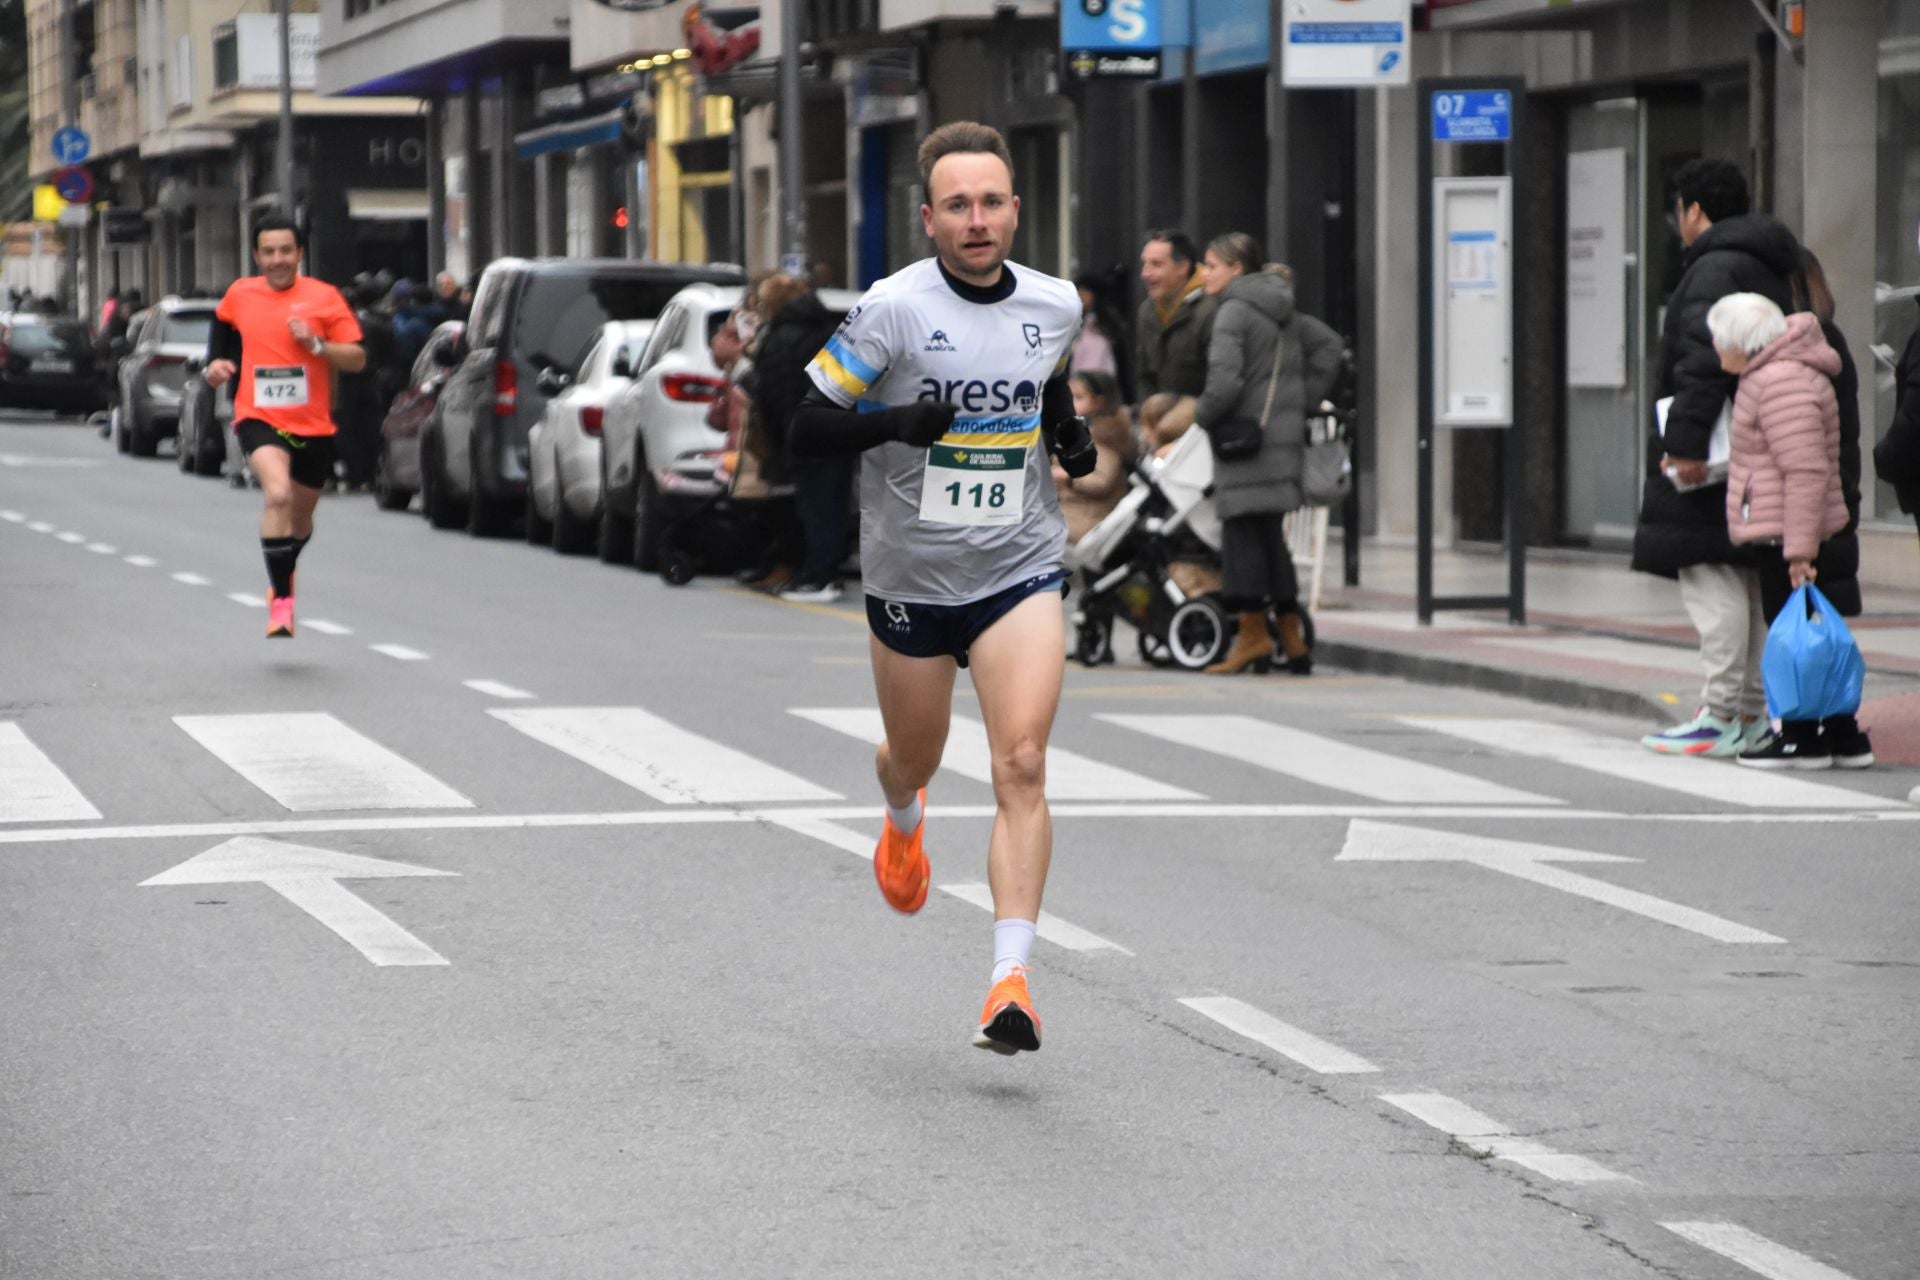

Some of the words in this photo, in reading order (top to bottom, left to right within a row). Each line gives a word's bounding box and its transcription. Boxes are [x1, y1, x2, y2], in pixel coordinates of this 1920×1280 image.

[1108, 0, 1147, 42] S
[1436, 94, 1465, 117] 07
[263, 384, 296, 398] 472
[951, 418, 1025, 434] enovables
[945, 482, 1005, 507] 118
